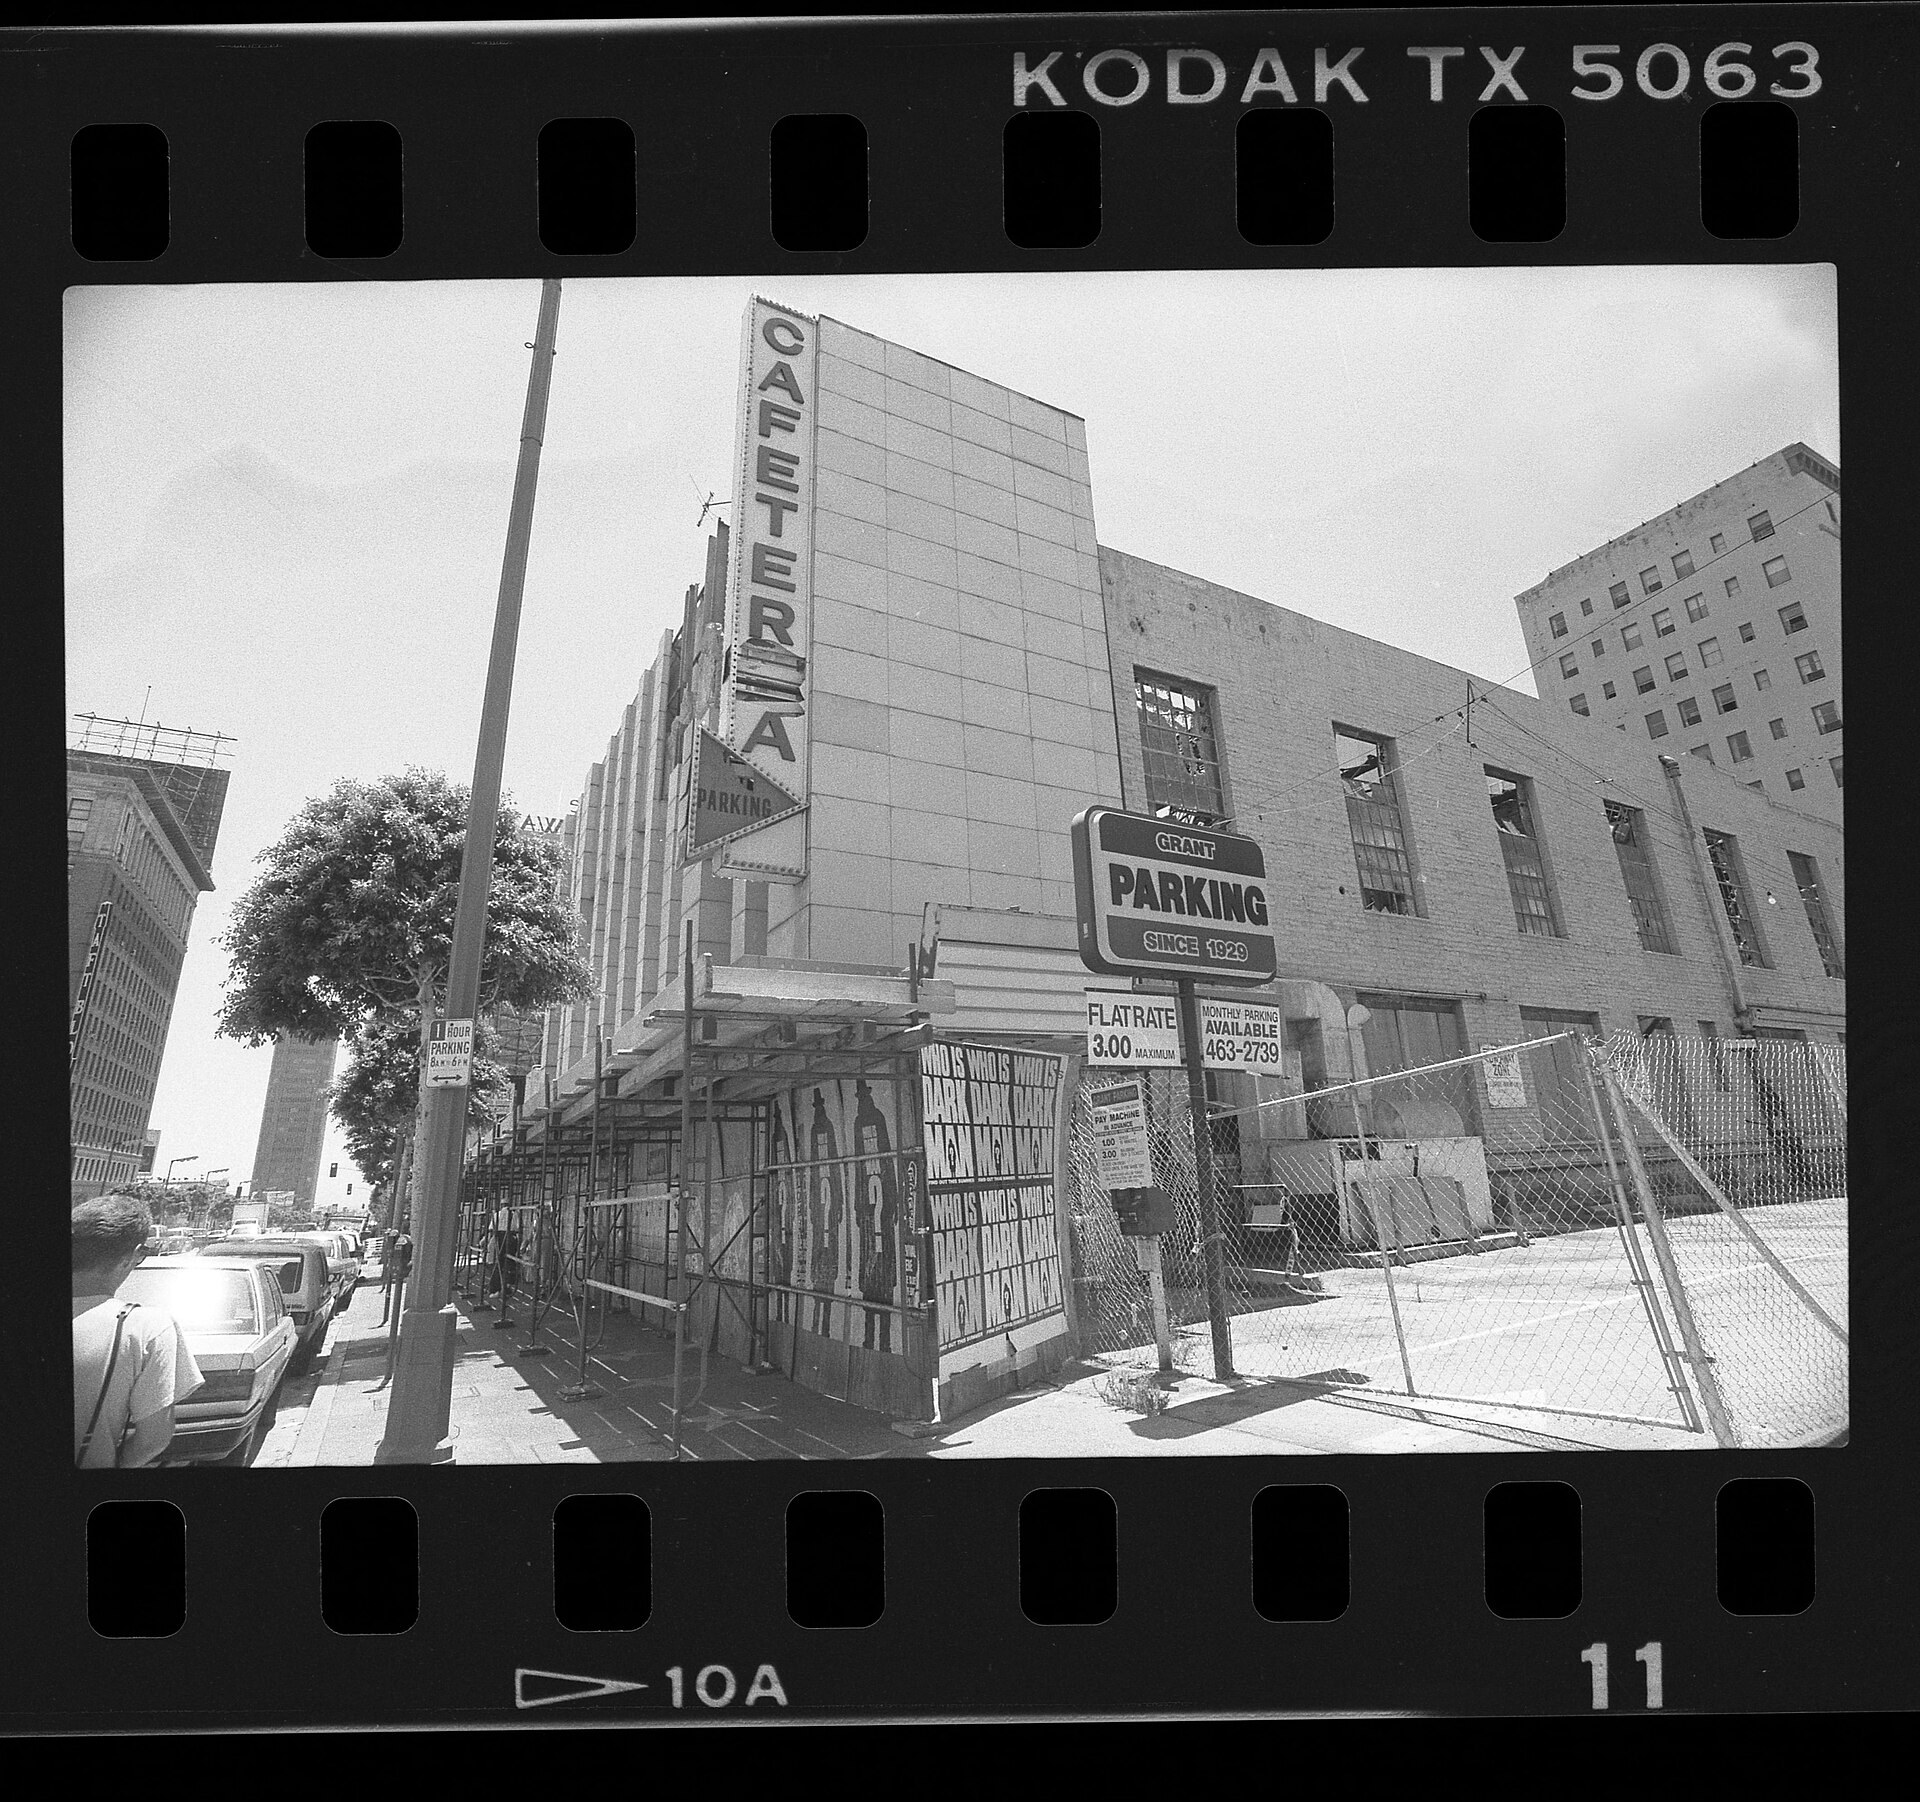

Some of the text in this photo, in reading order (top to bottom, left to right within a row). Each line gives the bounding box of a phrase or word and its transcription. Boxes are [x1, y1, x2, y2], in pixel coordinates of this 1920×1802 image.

[1013, 41, 1823, 107] KODAK TX 5063
[741, 317, 805, 762] CAFETERA
[697, 788, 771, 818] PARKING
[1156, 832, 1215, 859] GRANT
[1109, 863, 1268, 926] PARKING
[83, 913, 107, 987] TAFT
[1143, 931, 1248, 962] SINCE 1929
[436, 1023, 471, 1038] 1 HOUR
[1202, 1005, 1279, 1023] MONTHLY PARKING
[1205, 1020, 1278, 1038] AVAILABLE
[431, 1041, 470, 1055] PARKING
[921, 1043, 965, 1078] WHO IS
[966, 1049, 1010, 1083] WHO IS
[1093, 1034, 1176, 1060] 3.00 MAXIMUM
[1206, 1039, 1279, 1064] 463-2739
[1014, 1055, 1058, 1087] WHO IS
[922, 1075, 970, 1124] DARK
[970, 1081, 1013, 1125] DARK
[1014, 1086, 1056, 1126] DARK
[1095, 1115, 1107, 1124] PAY
[1110, 1109, 1140, 1121] MACHINE
[925, 1124, 975, 1178] MAN
[974, 1125, 1015, 1177] MAN
[1015, 1127, 1054, 1174] MAN
[1102, 1150, 1117, 1159] 3.00
[930, 1193, 962, 1231] WHO
[963, 1191, 978, 1227] IS
[979, 1187, 1018, 1225] WHO IS
[1019, 1184, 1054, 1219] WHO IS
[933, 1226, 981, 1284] DARK
[981, 1220, 1022, 1273] DARK
[1022, 1214, 1058, 1264] DARK
[984, 1264, 1027, 1330] MAN
[1025, 1256, 1063, 1315] MAN
[936, 1275, 984, 1345] MAN
[665, 1664, 789, 1708] 10A
[1581, 1642, 1663, 1710] 11
